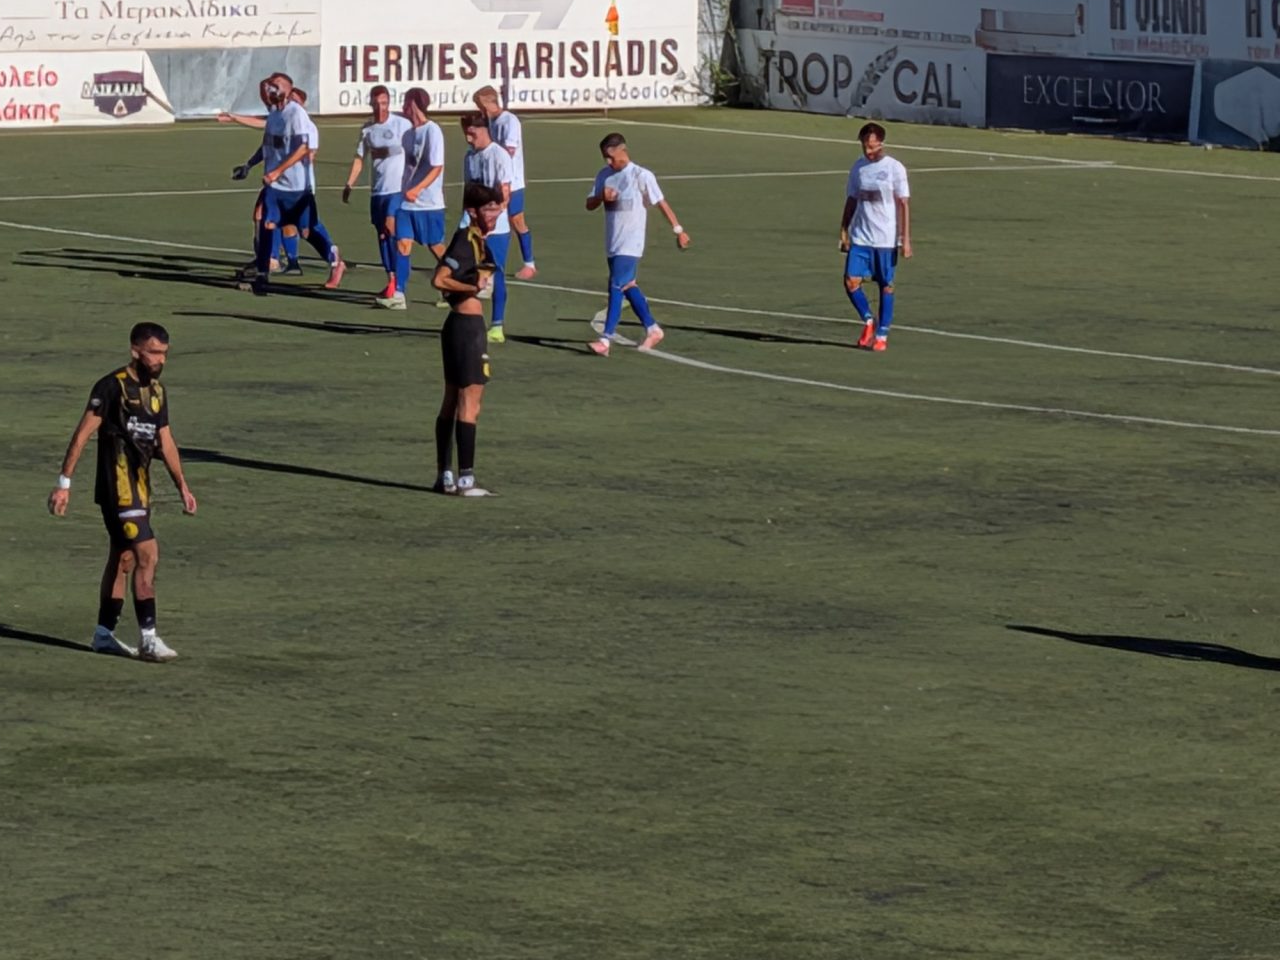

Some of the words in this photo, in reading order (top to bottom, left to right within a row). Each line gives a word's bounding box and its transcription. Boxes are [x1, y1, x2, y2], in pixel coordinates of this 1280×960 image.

[55, 1, 88, 20] Τα
[339, 42, 478, 83] HERMES
[490, 38, 679, 80] HARISIADIS
[1023, 74, 1167, 114] EXCELSIOR
